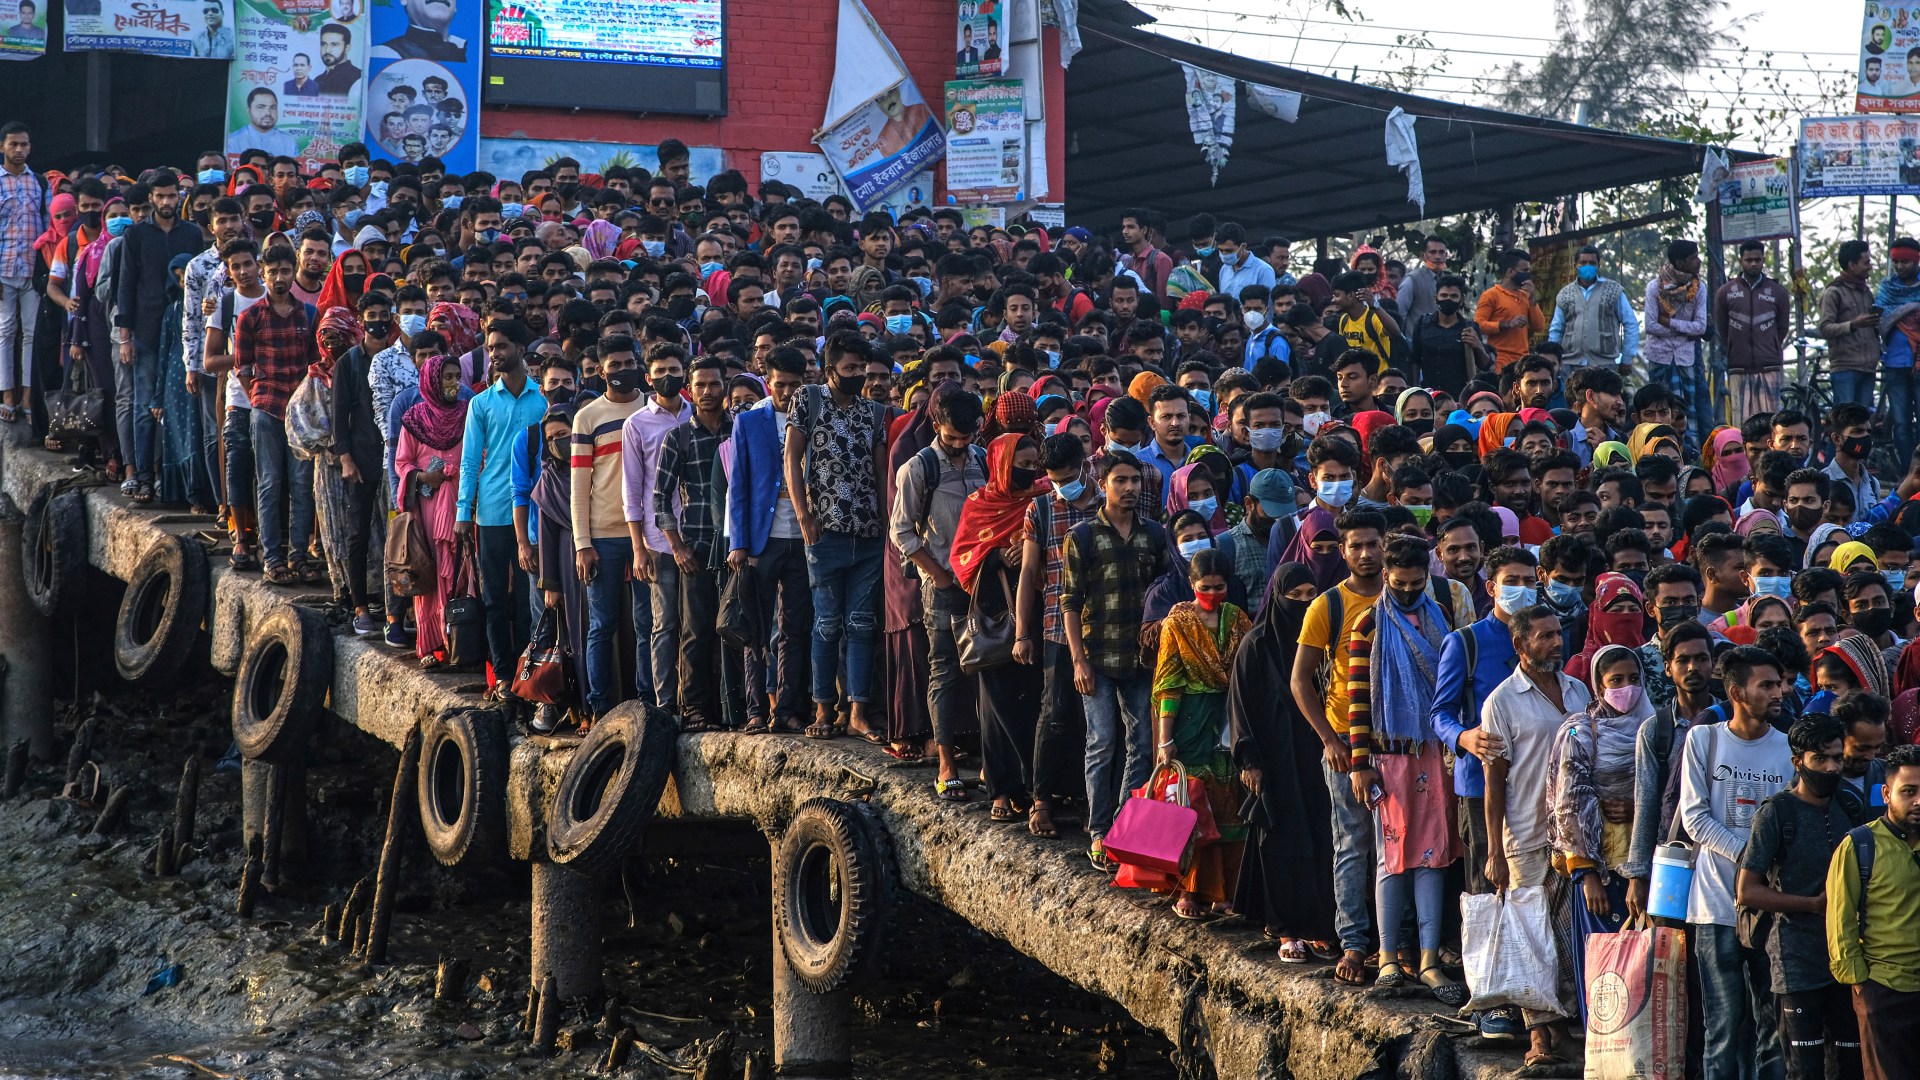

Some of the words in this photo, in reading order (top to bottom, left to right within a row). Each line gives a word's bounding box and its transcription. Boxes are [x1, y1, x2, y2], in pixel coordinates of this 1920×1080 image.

[1895, 27, 1920, 37] শারদী
[1804, 122, 1825, 140] ভাই
[1827, 122, 1850, 141] ভাই
[1853, 120, 1882, 140] ট্রেনিং
[1884, 119, 1919, 138] সেন্টার
[854, 180, 876, 200] মোঃ
[871, 159, 905, 185] ইকরাম
[900, 132, 943, 166] ইজারাদার
[1712, 764, 1783, 784] Division
[1656, 979, 1664, 1011] CEMENT
[1656, 1012, 1664, 1039] BRAND
[1656, 1040, 1664, 1059] KING
